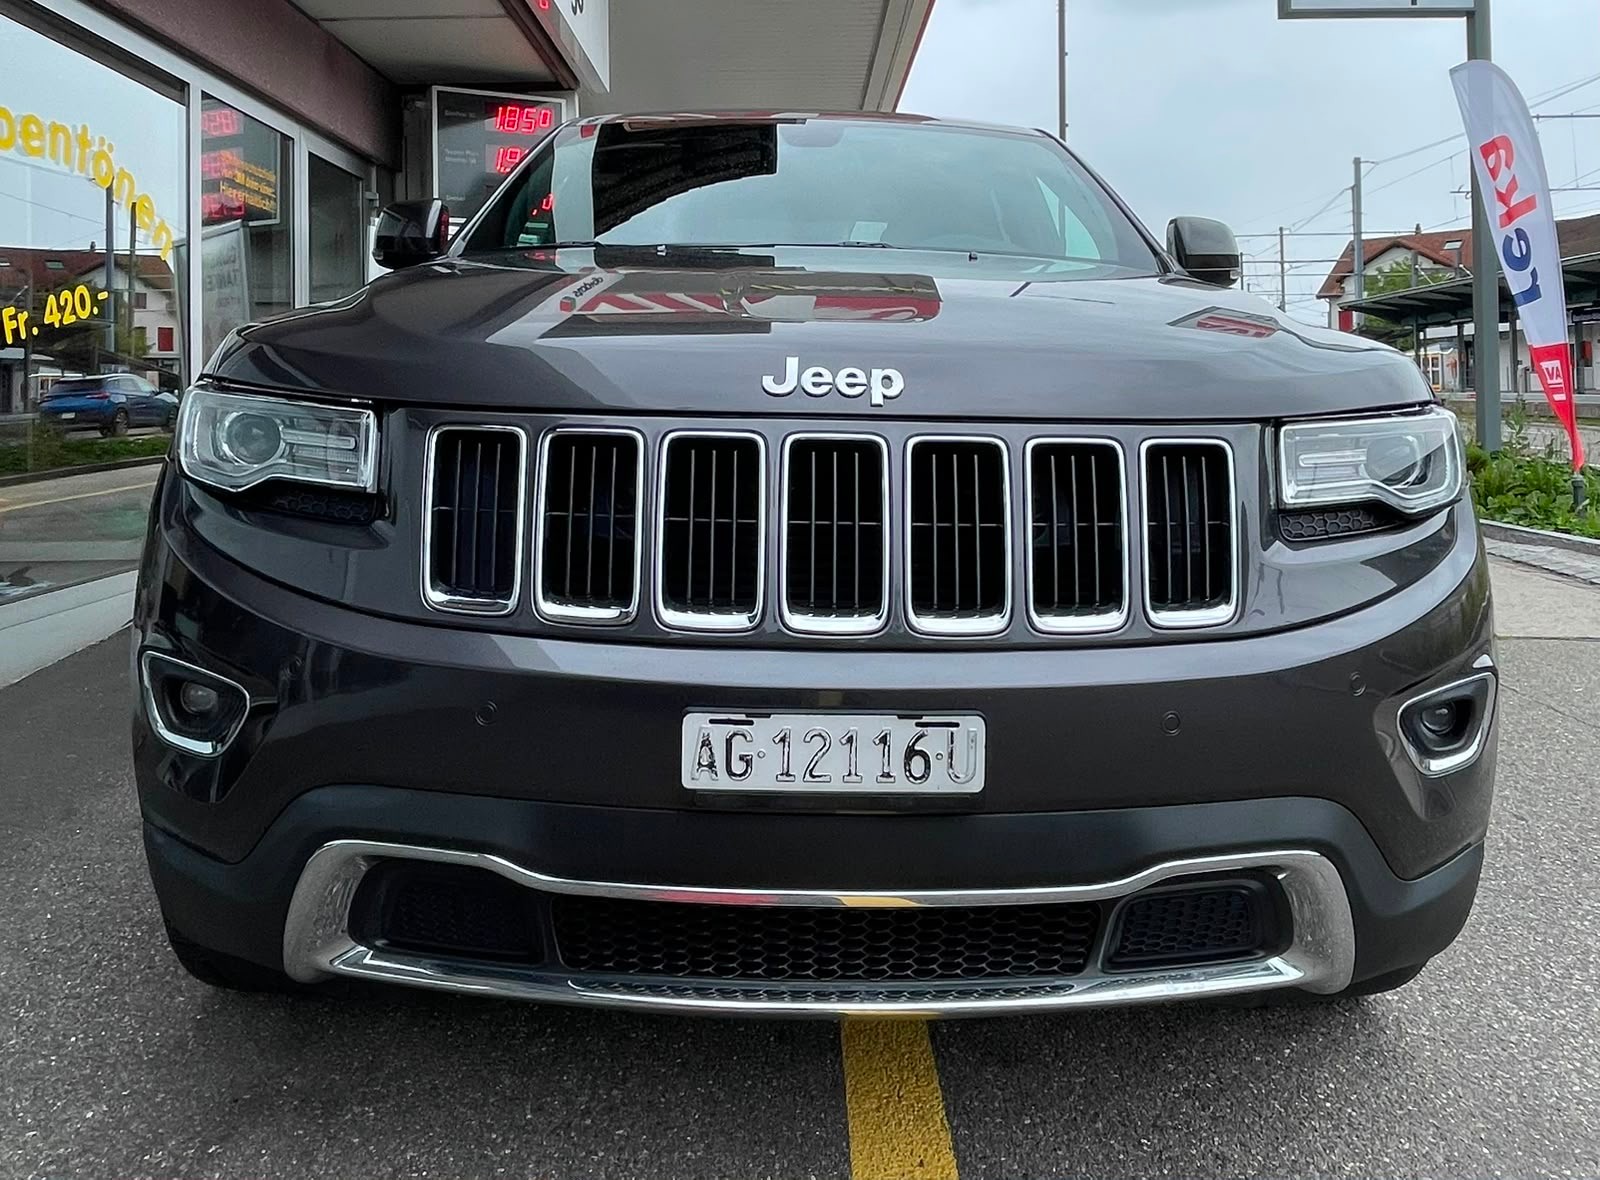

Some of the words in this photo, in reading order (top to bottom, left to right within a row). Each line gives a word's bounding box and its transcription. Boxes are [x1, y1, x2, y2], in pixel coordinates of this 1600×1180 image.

[1480, 135, 1542, 308] reka
[2, 306, 39, 345] Fr.
[43, 284, 109, 329] 420.-
[761, 355, 905, 407] Jeep
